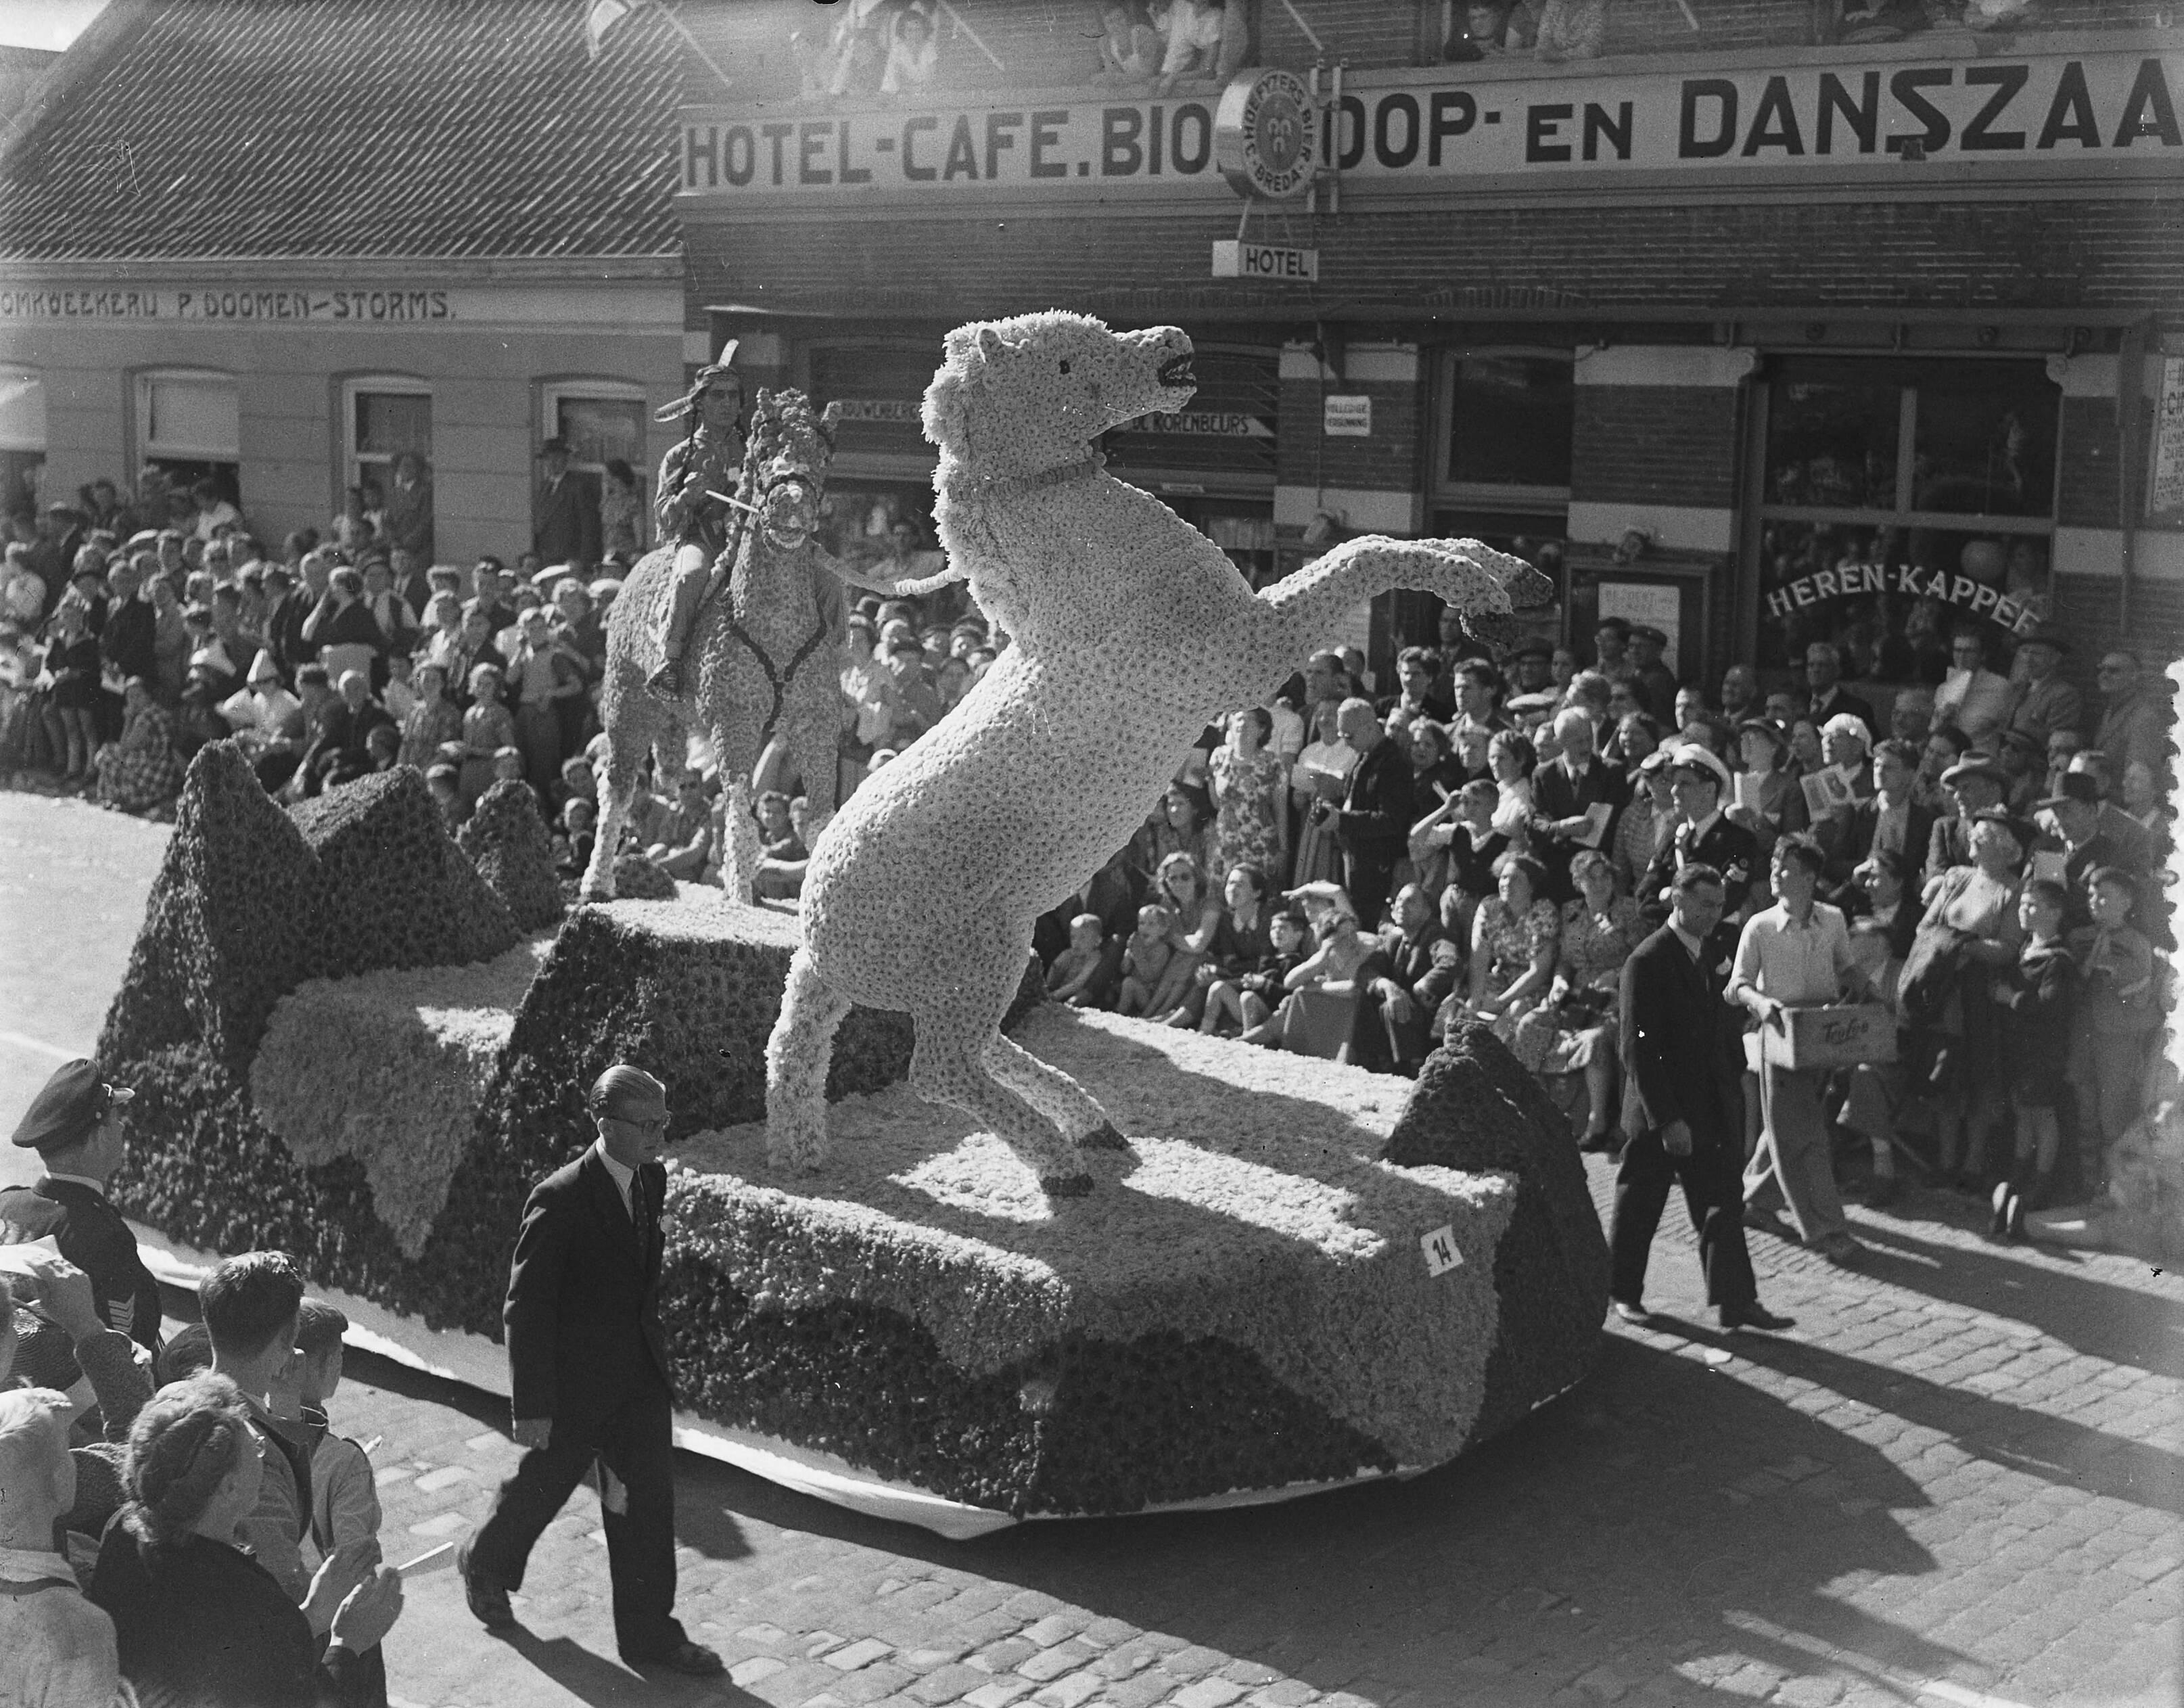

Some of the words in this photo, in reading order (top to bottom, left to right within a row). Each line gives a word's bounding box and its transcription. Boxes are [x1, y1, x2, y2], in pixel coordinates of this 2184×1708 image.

[1526, 101, 1633, 162] EN
[1254, 164, 1302, 192] BREDA
[1246, 248, 1309, 277] HOTEL
[1152, 413, 1249, 435] KORENBEURS
[1432, 1234, 1452, 1266] 14
